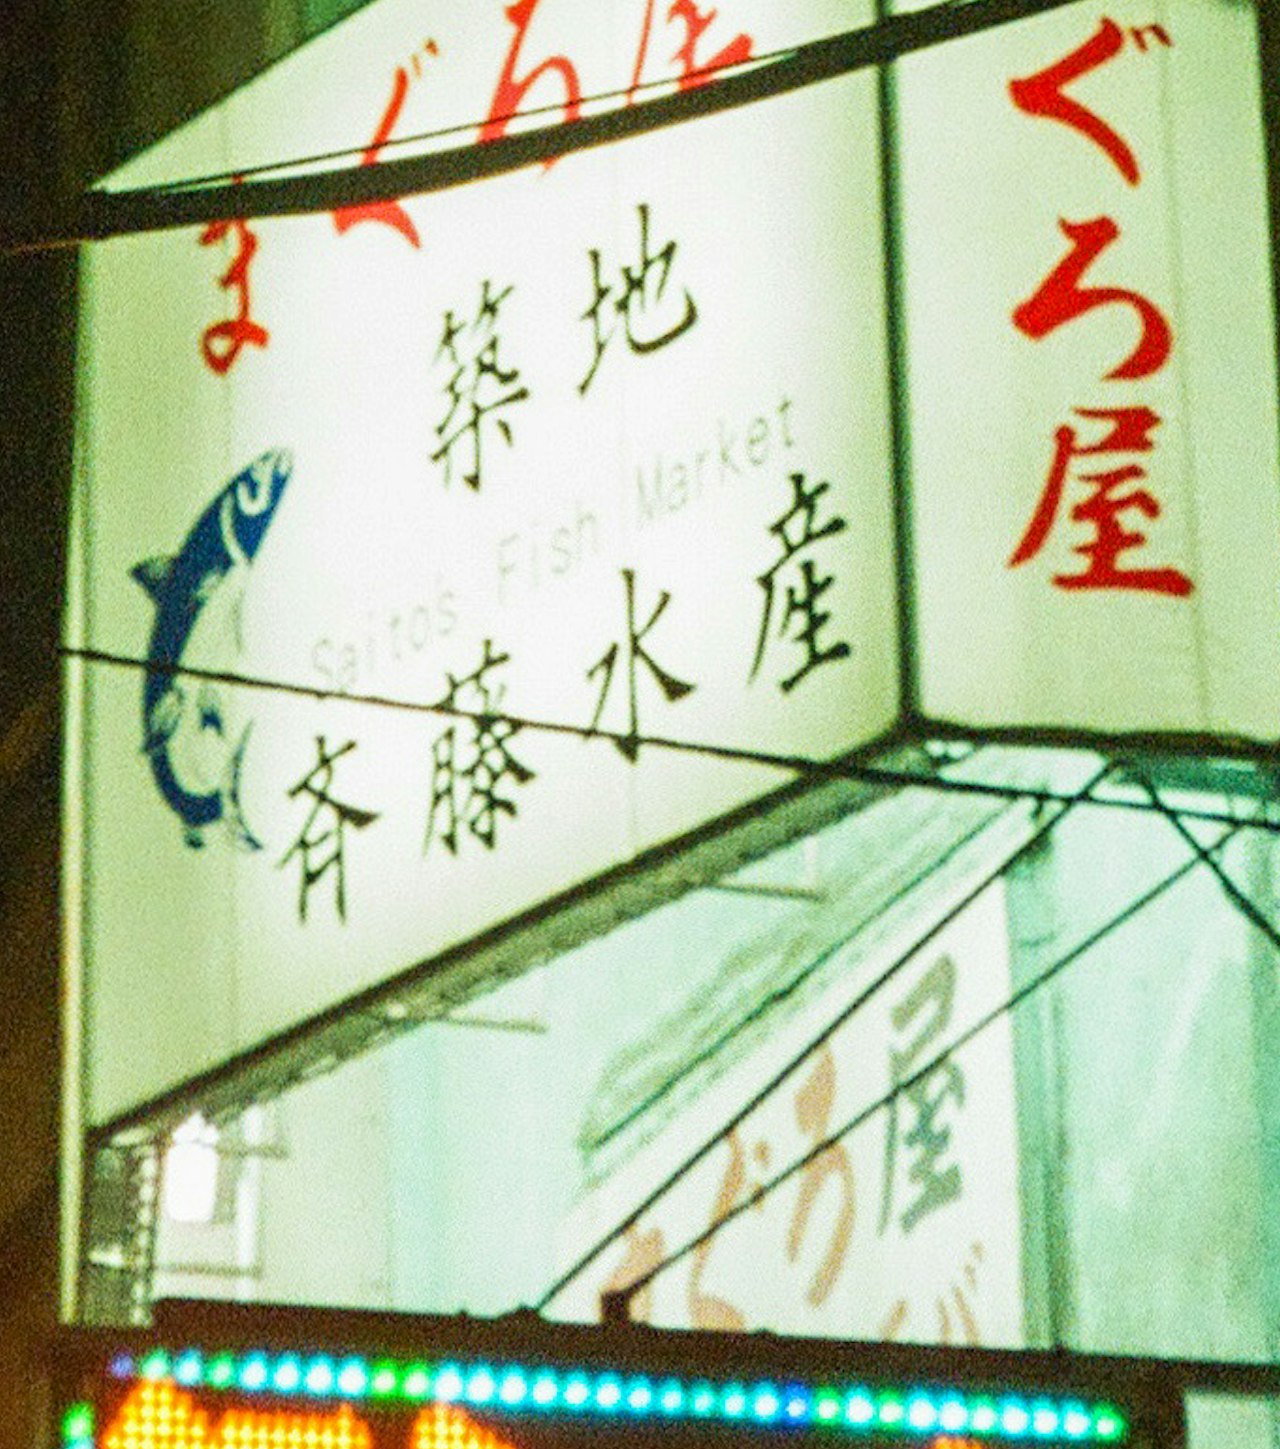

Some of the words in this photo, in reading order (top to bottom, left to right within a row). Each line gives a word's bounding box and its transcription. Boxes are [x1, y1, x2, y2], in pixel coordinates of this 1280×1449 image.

[426, 204, 698, 492] 築地
[496, 502, 602, 610] Fish
[633, 394, 798, 528] Market
